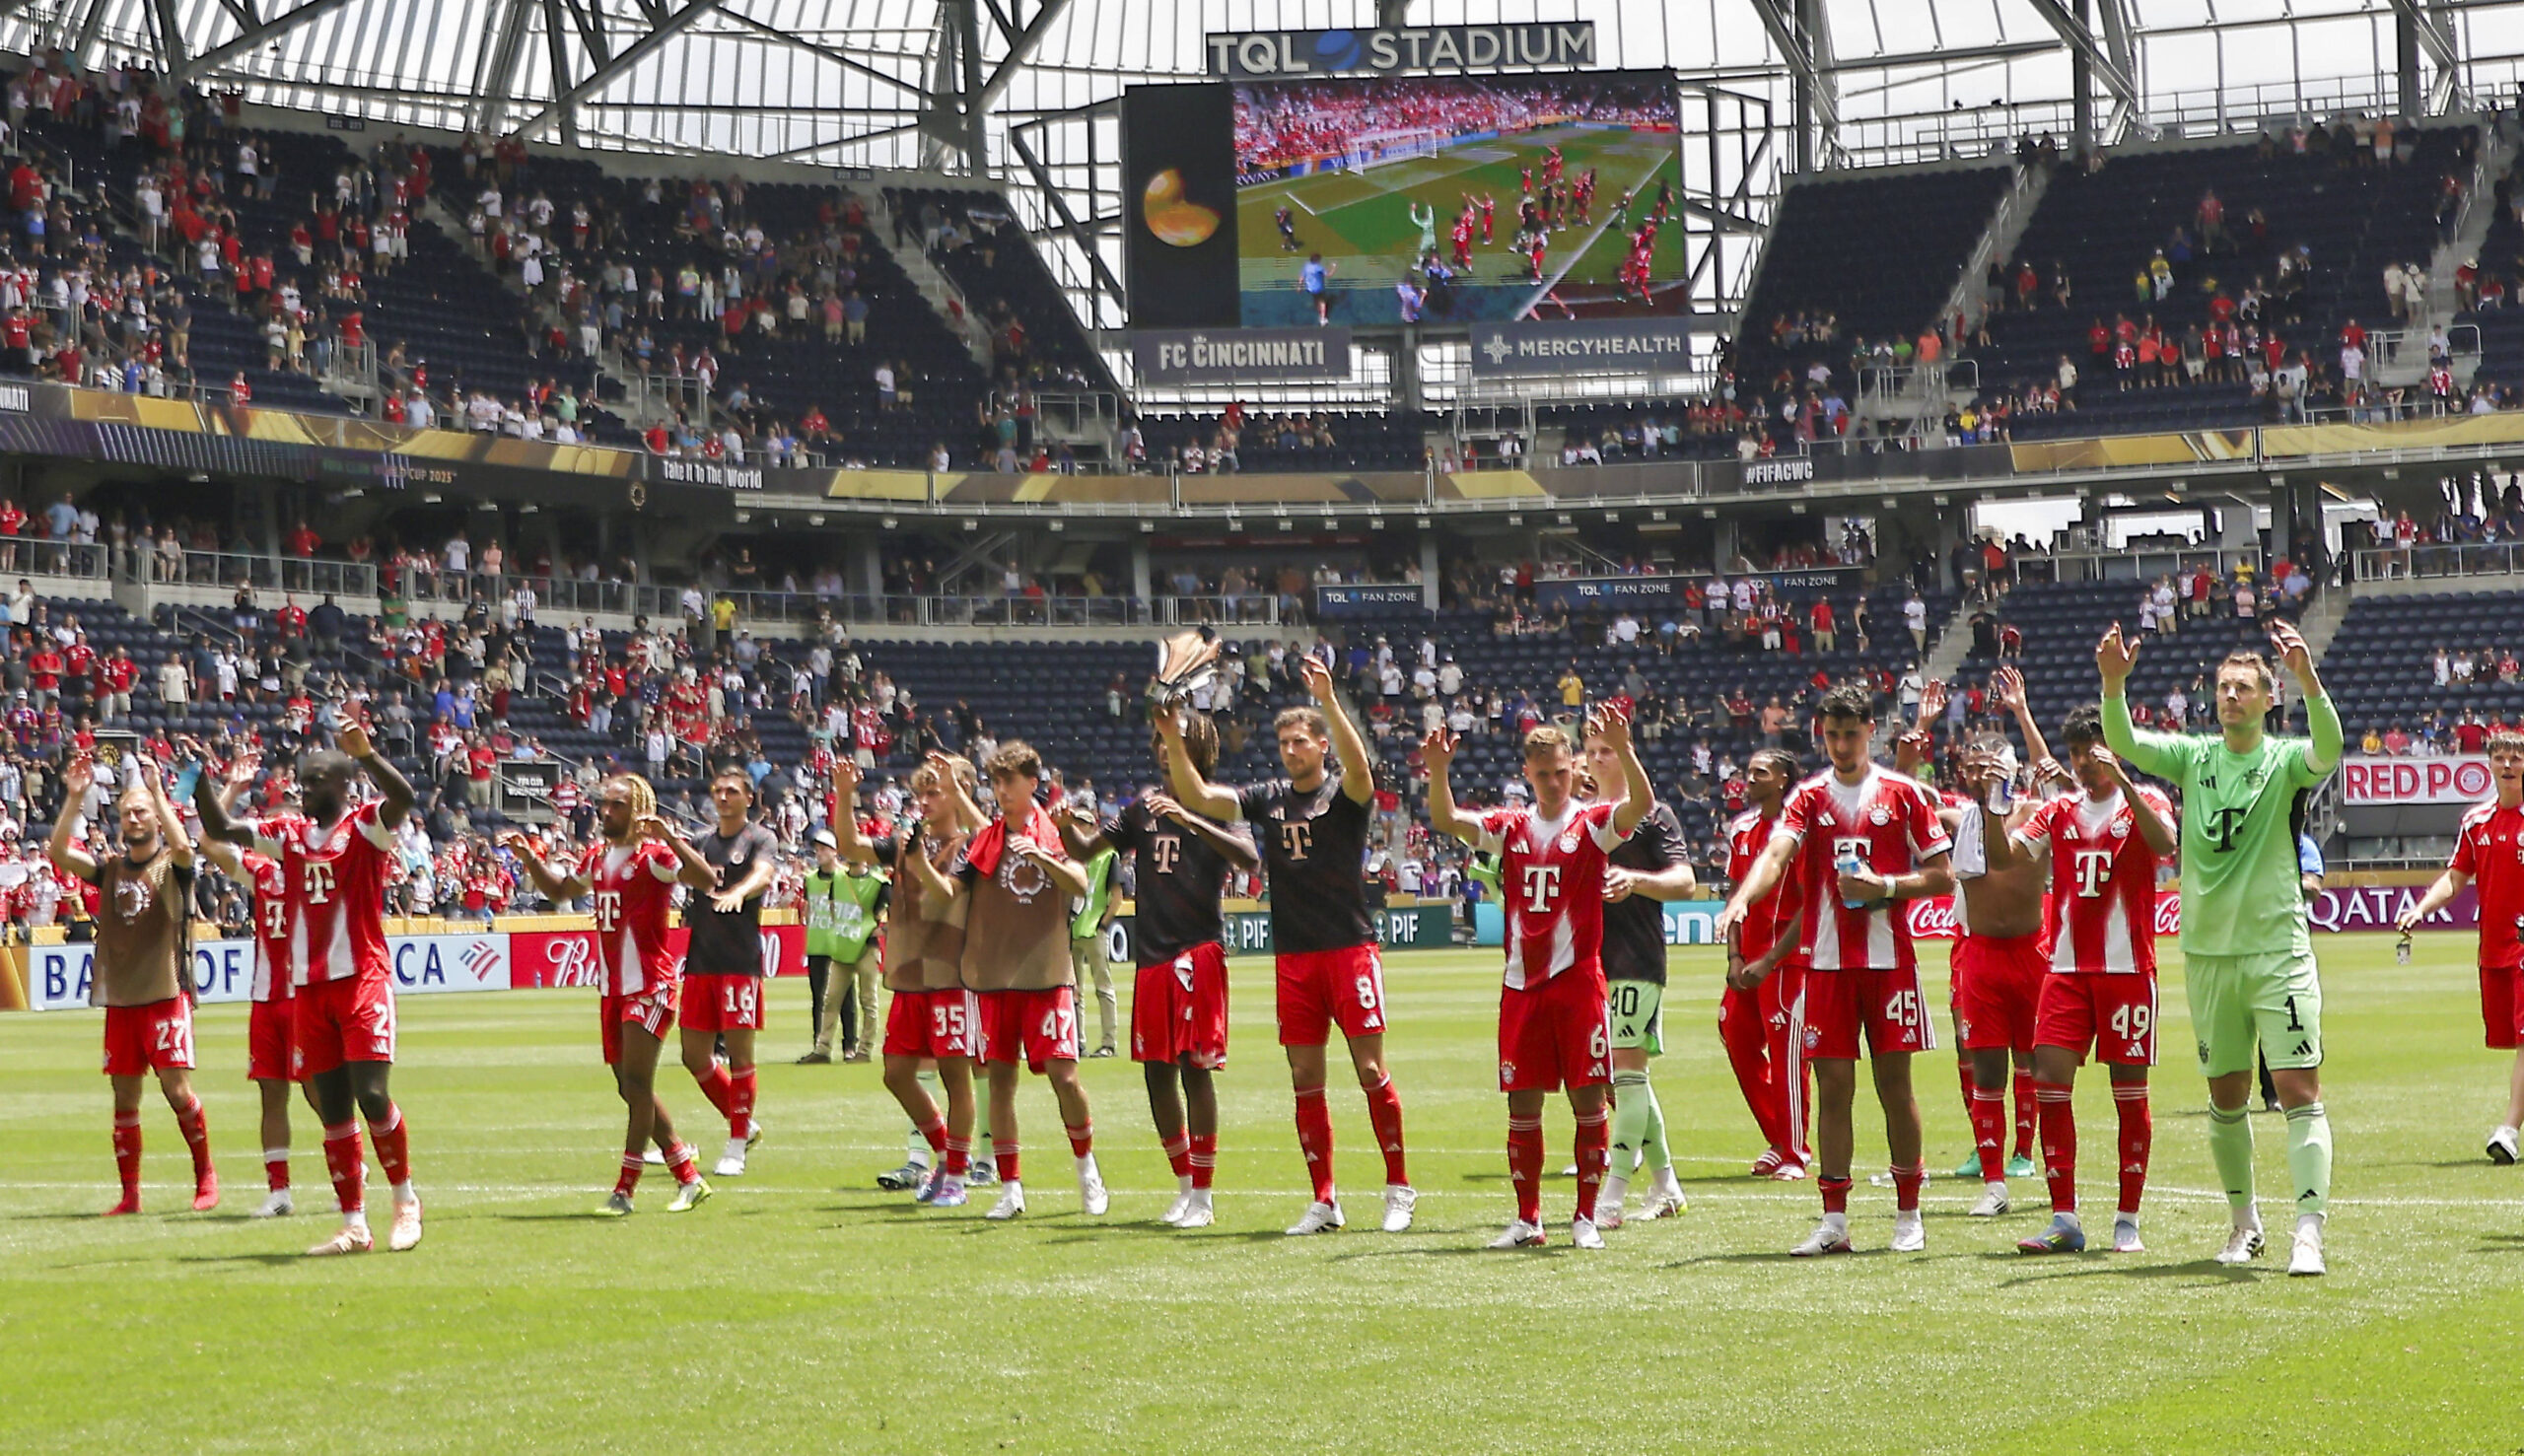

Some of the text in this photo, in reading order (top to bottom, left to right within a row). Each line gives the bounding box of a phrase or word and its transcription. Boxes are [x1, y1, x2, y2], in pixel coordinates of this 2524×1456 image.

[1209, 26, 1594, 75] TQL STADIUM
[1160, 341, 1324, 371] FC CINCINNATI
[1519, 336, 1681, 357] MERCYHEALTH
[663, 460, 684, 481] Take
[706, 465, 723, 485] The
[727, 468, 762, 489] World
[1326, 592, 1417, 603] TQL FAN ZONE
[1578, 584, 1671, 596] TQL FAN ZONE
[1750, 576, 1838, 589] TQ FAN ZONE
[2346, 762, 2491, 799] RED PO
[1283, 820, 1313, 861] T
[2207, 807, 2247, 853] T
[1154, 837, 1181, 873] T
[305, 862, 335, 904] T
[1523, 867, 1561, 913] T
[2075, 851, 2112, 898] T
[597, 891, 621, 932] T
[1391, 915, 1420, 943] PIF
[1243, 920, 1269, 948] PIF
[197, 949, 243, 996] OF
[726, 986, 754, 1012] 16
[1356, 976, 1376, 1008] 8
[1886, 990, 1919, 1026] 45
[373, 1002, 389, 1036] 2
[933, 1005, 966, 1037] 35
[1042, 1009, 1073, 1041] 47
[2111, 1004, 2150, 1040] 49
[2284, 996, 2304, 1033] 1
[155, 1019, 186, 1051] 27
[1590, 1023, 1607, 1059] 6
